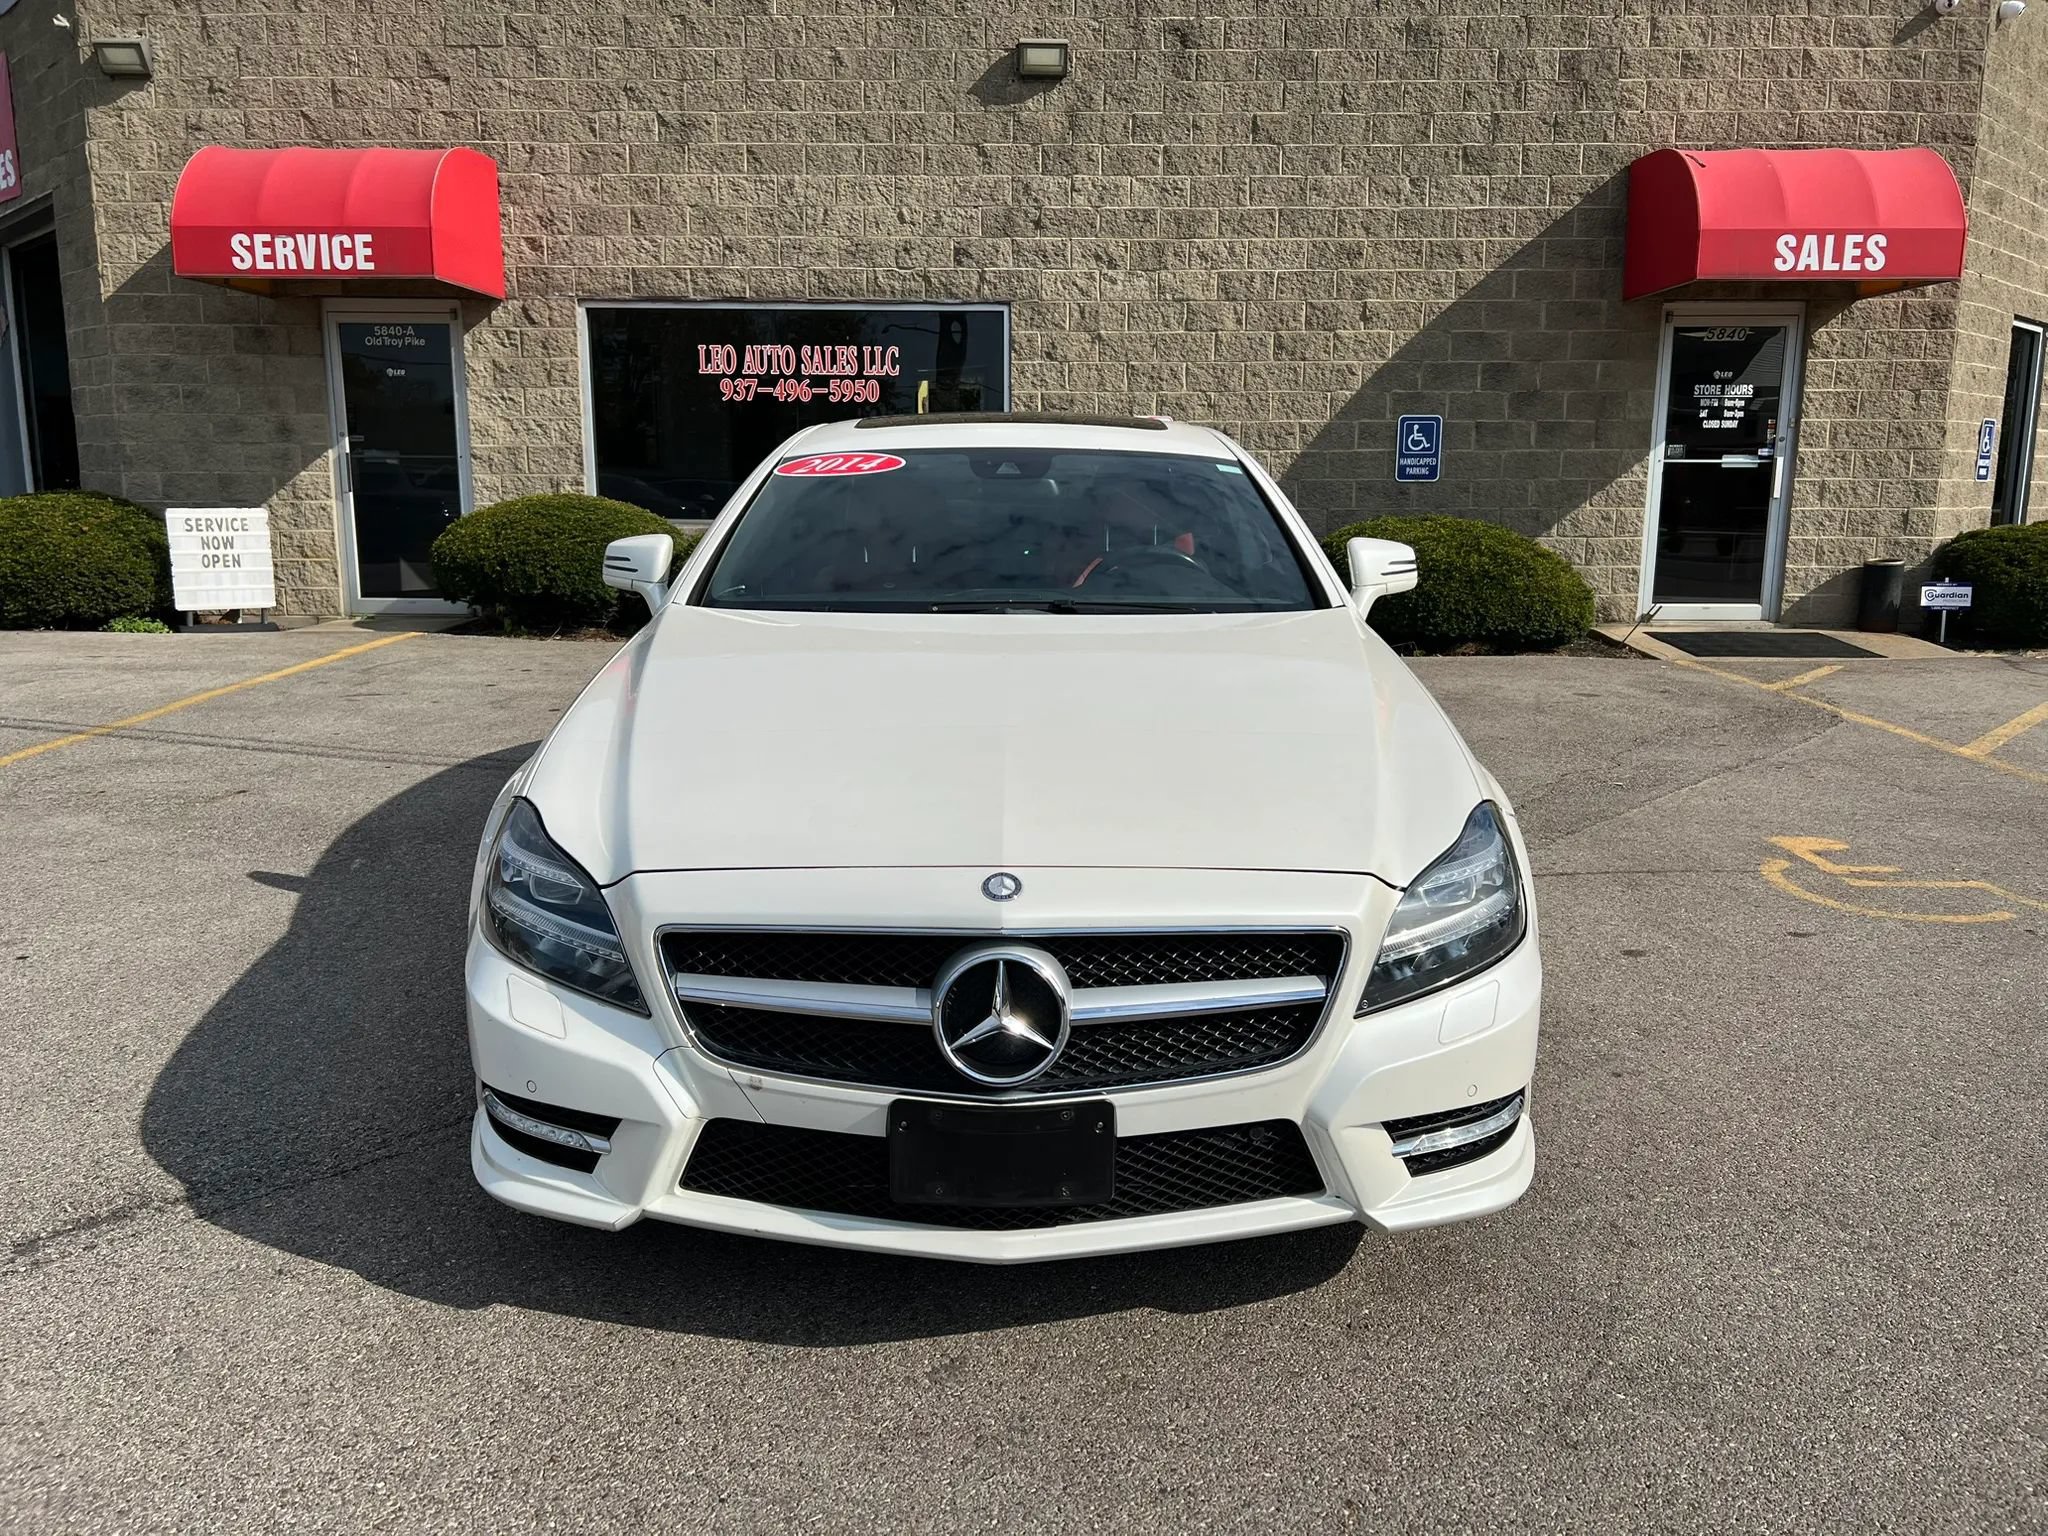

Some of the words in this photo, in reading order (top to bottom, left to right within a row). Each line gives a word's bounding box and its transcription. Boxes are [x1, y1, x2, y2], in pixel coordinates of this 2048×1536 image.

[230, 233, 375, 271] SERVICE
[1773, 233, 1888, 272] SALES
[374, 326, 415, 336] 5840-A
[1706, 328, 1748, 340] 5840
[365, 337, 382, 346] Old
[383, 336, 403, 348] Troy
[405, 336, 426, 346] Pike
[698, 344, 737, 375] LEO
[742, 344, 796, 376] AUTO
[801, 345, 858, 376] SALES
[863, 346, 900, 376] LLC
[720, 378, 880, 403] 937-496-5950
[1694, 384, 1722, 395] STORE
[1724, 384, 1754, 395] HOURS
[1702, 420, 1720, 429] CLOSED
[1721, 420, 1739, 429] SUNDAY
[790, 455, 889, 475] 2014
[1400, 457, 1437, 466] HANDICAPPED
[1405, 467, 1430, 475] PARKING
[184, 517, 249, 532] SERVICE
[200, 535, 235, 551] NOW
[201, 553, 242, 569] OPEN
[1924, 589, 1969, 602] Guardian
